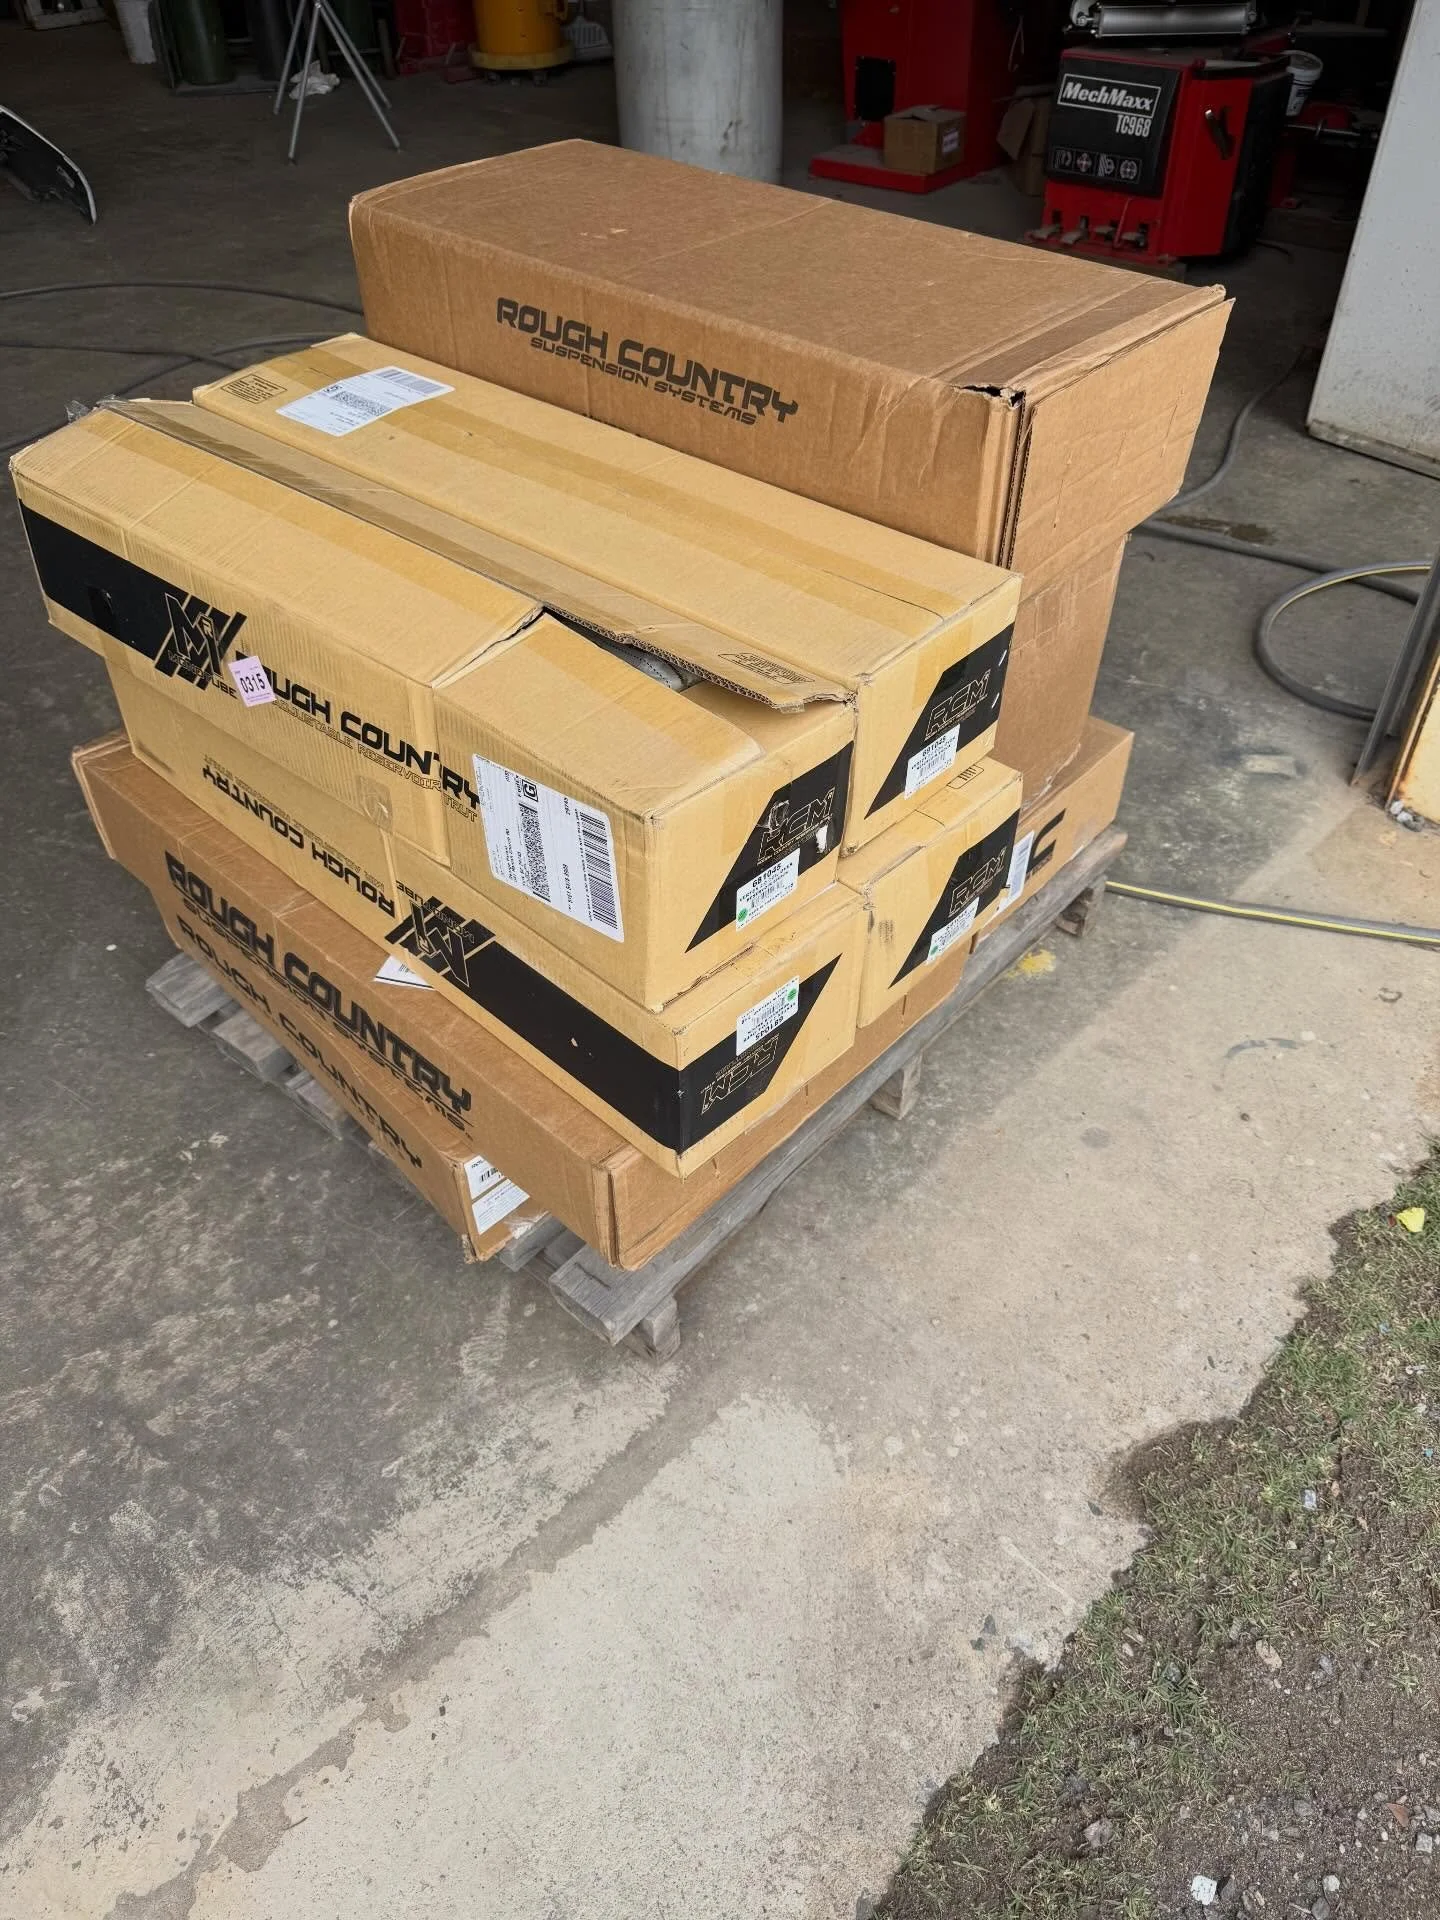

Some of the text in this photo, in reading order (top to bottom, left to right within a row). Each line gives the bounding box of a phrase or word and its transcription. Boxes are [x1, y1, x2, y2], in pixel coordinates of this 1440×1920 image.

[1062, 82, 1153, 111] MechMaxx
[1116, 114, 1152, 138] TC968
[496, 297, 799, 424] ROUGH COUNTRY
[530, 337, 758, 426] SUSPENSION SYSTEMS
[236, 650, 331, 724] UGH
[240, 672, 266, 694] 0315
[202, 765, 305, 850] COUNTRY
[311, 842, 396, 919] ROUGH
[165, 850, 472, 1114] ROUGH COUNTRY
[176, 913, 422, 1168] ROUGH COUNTRY
